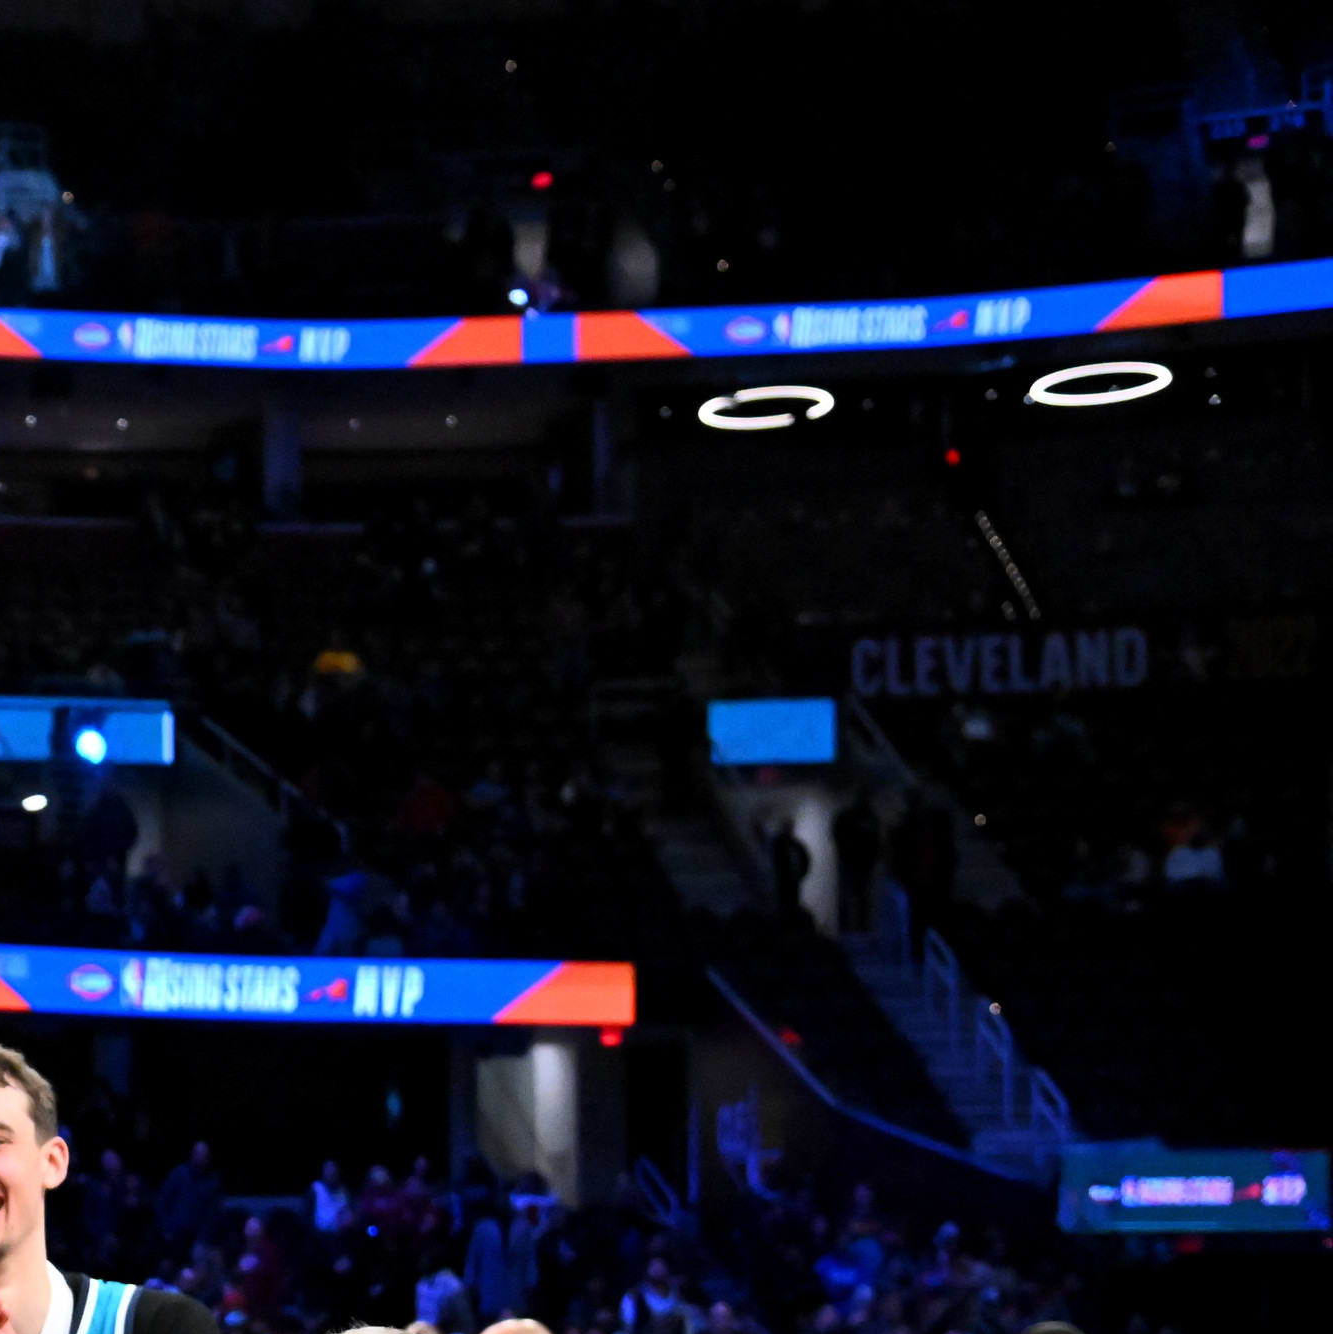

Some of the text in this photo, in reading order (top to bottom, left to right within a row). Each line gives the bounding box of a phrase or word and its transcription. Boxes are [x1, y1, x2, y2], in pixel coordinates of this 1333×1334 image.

[847, 624, 1150, 698] CLEVELAND
[141, 957, 224, 1011] RISING
[224, 963, 300, 1013] STARS
[353, 964, 426, 1018] MVP
